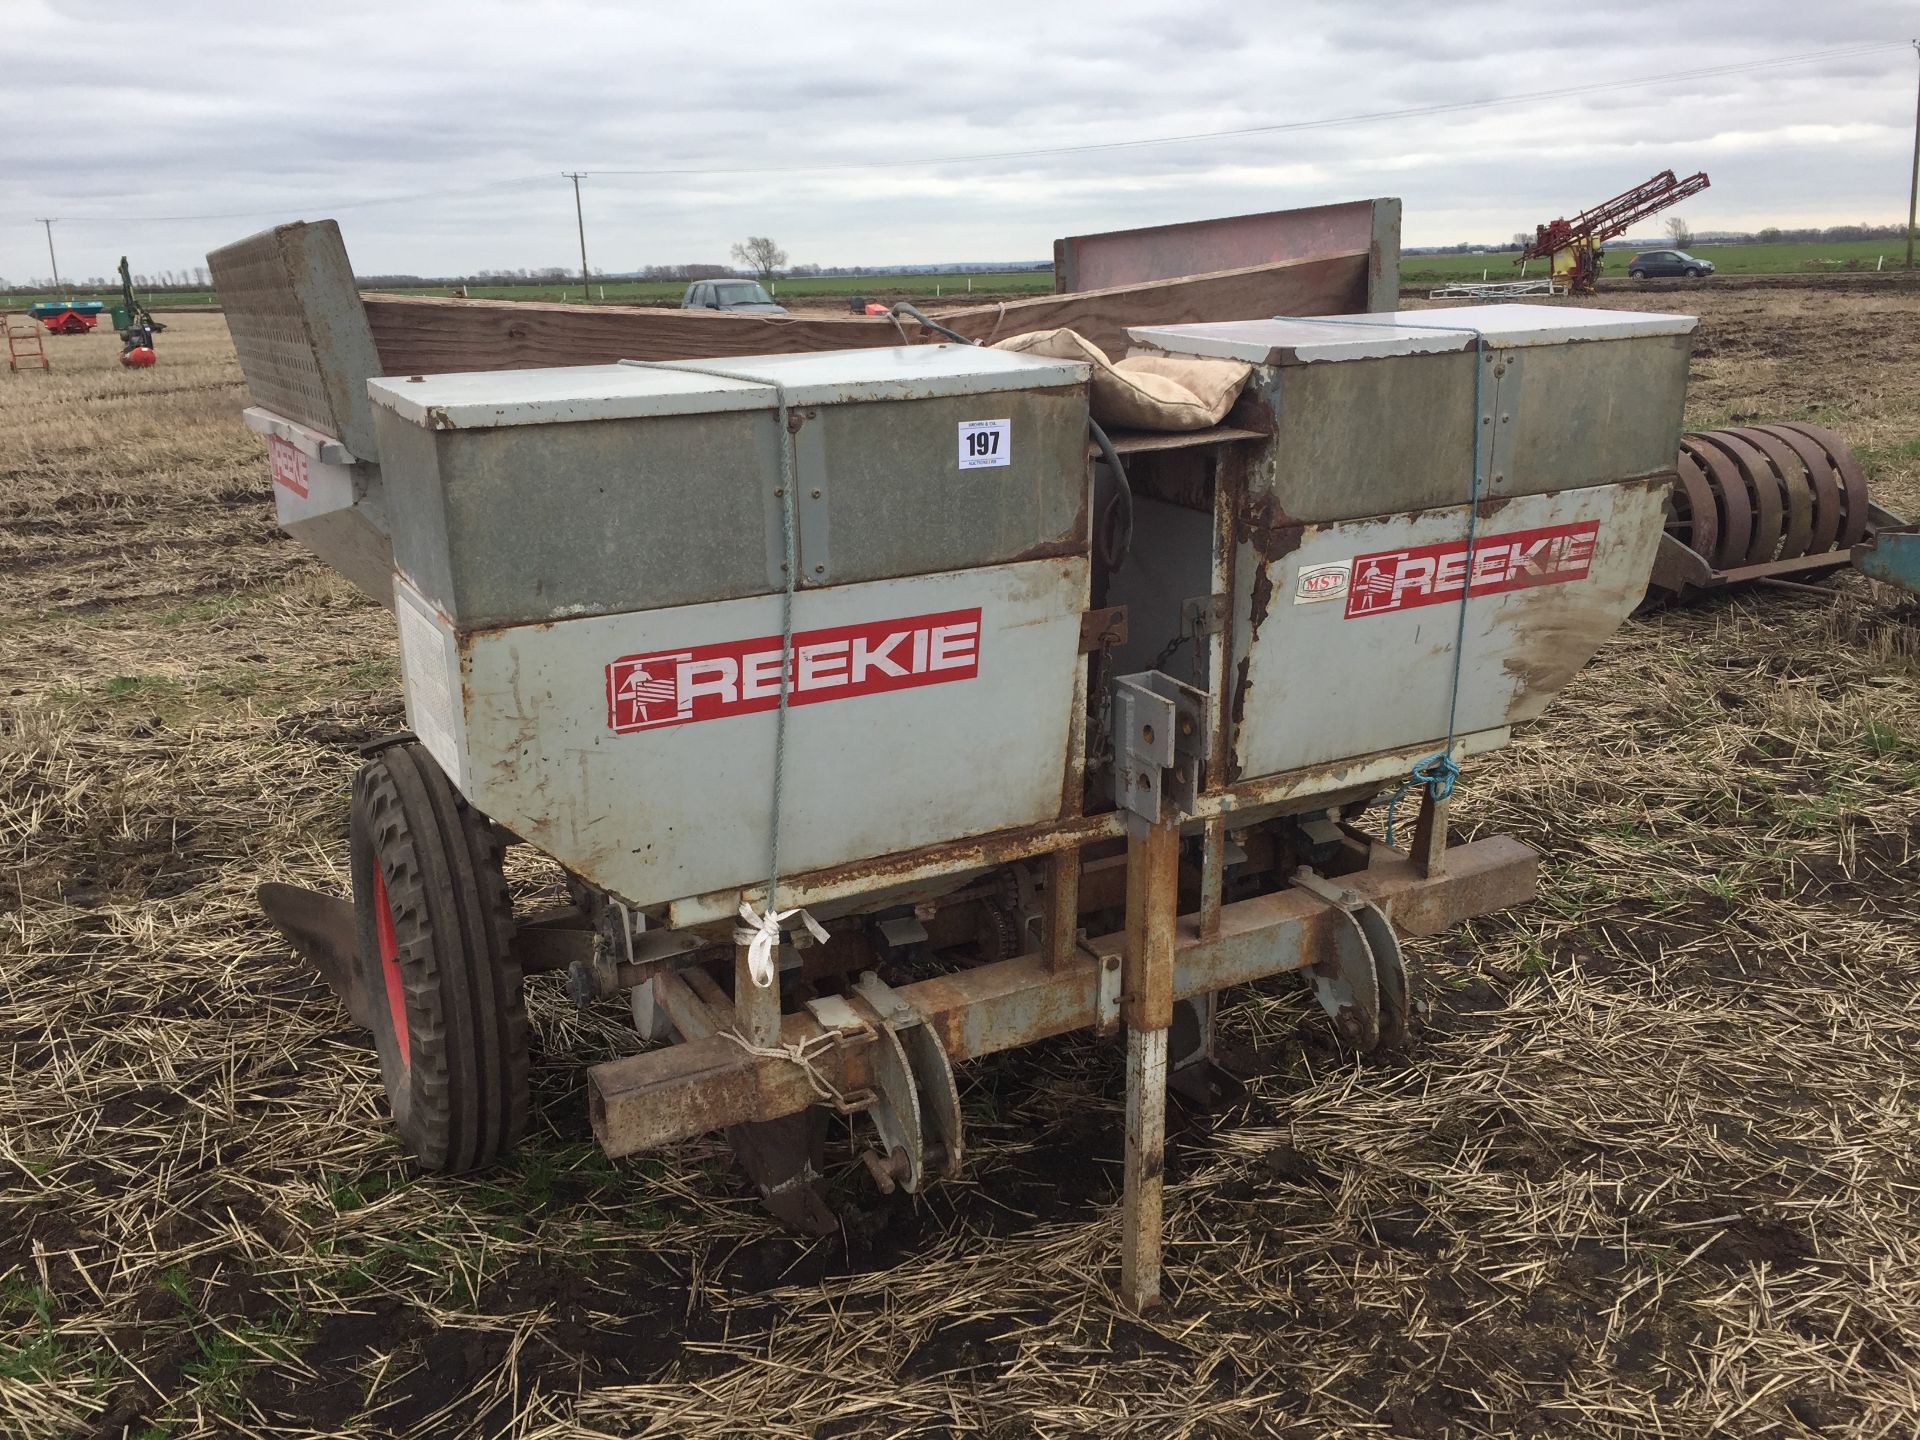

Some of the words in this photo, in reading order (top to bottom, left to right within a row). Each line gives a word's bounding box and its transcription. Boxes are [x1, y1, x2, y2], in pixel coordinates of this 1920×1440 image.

[966, 431, 1000, 457] 197
[1307, 575, 1341, 591] MST
[1392, 532, 1596, 599] REEKIE
[676, 621, 978, 711] REEKIE
